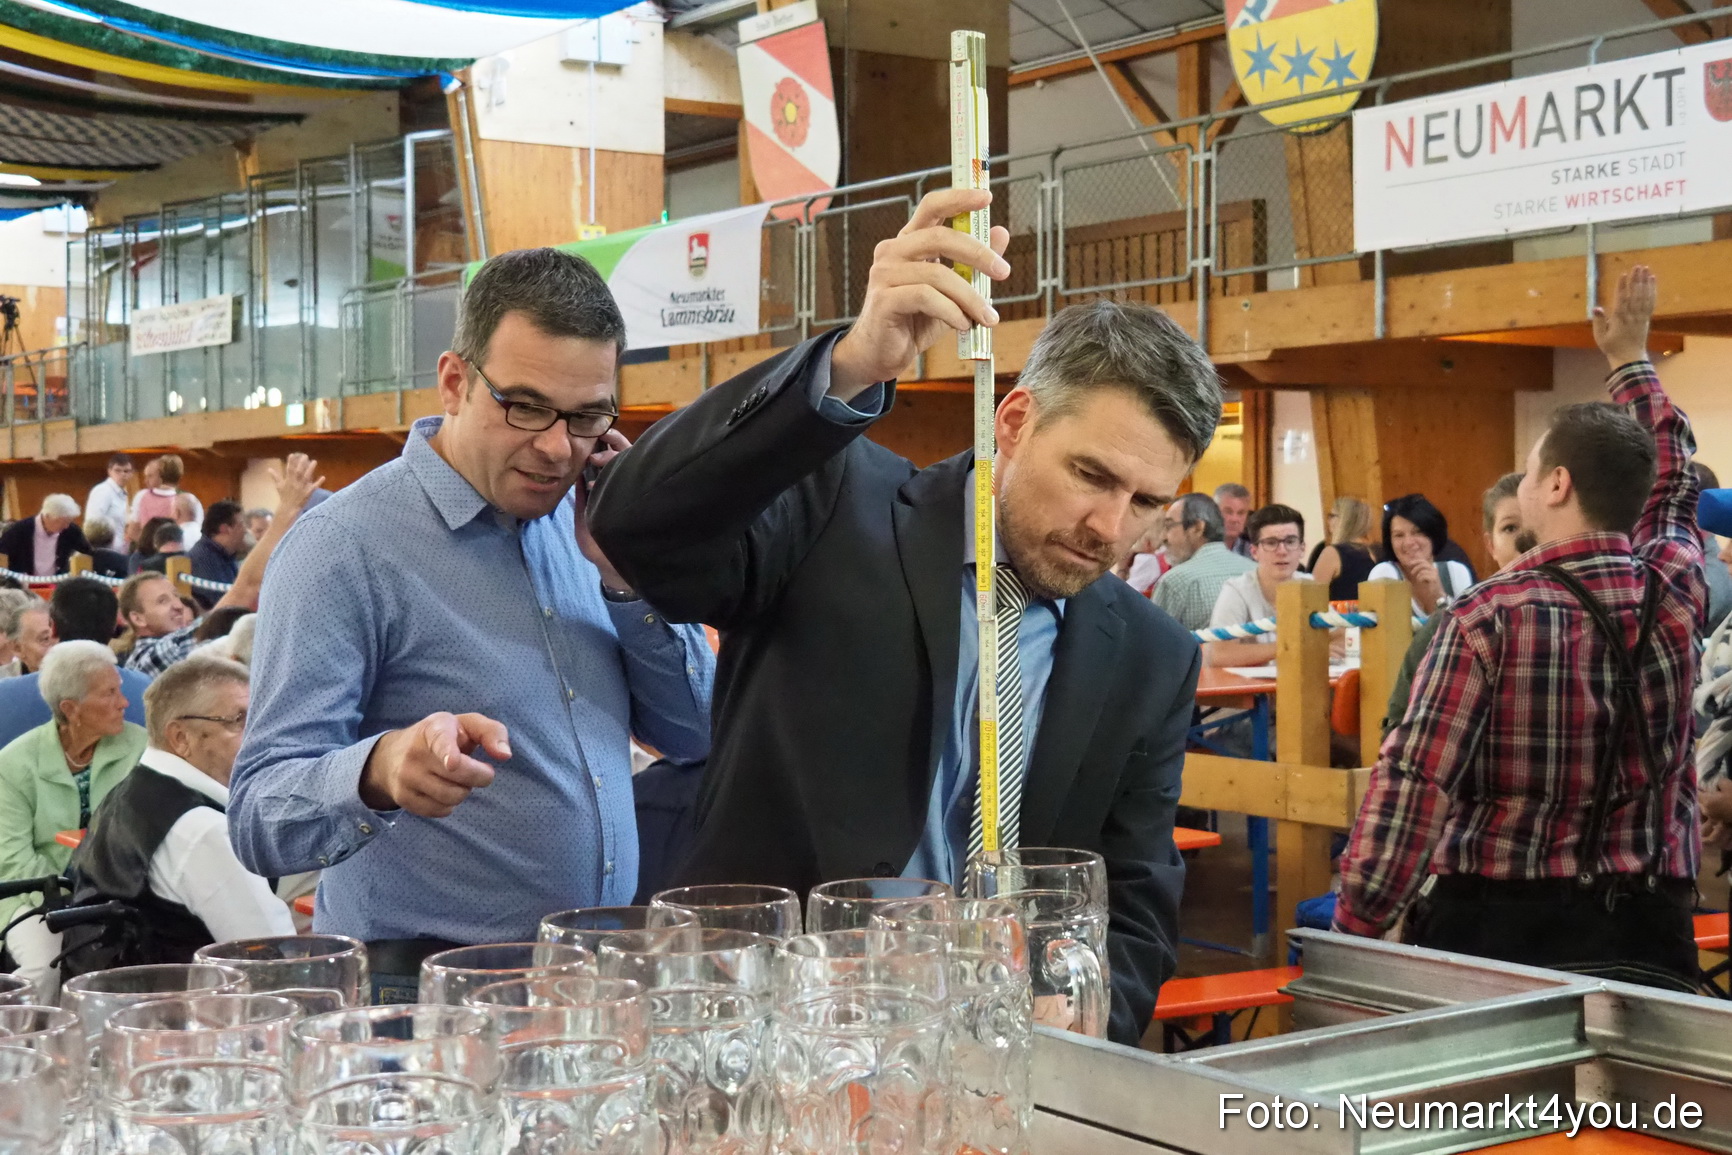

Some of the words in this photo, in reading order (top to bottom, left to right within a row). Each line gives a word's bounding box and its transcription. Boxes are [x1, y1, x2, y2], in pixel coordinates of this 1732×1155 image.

[1384, 67, 1686, 172] NEUMARKT
[1551, 161, 1620, 185] STARKE
[1628, 151, 1686, 174] STADT
[1493, 196, 1558, 220] STARKE
[1565, 179, 1687, 210] WIRTSCHAFT
[670, 287, 725, 304] Neumarkter
[661, 304, 735, 328] Lammsbräu
